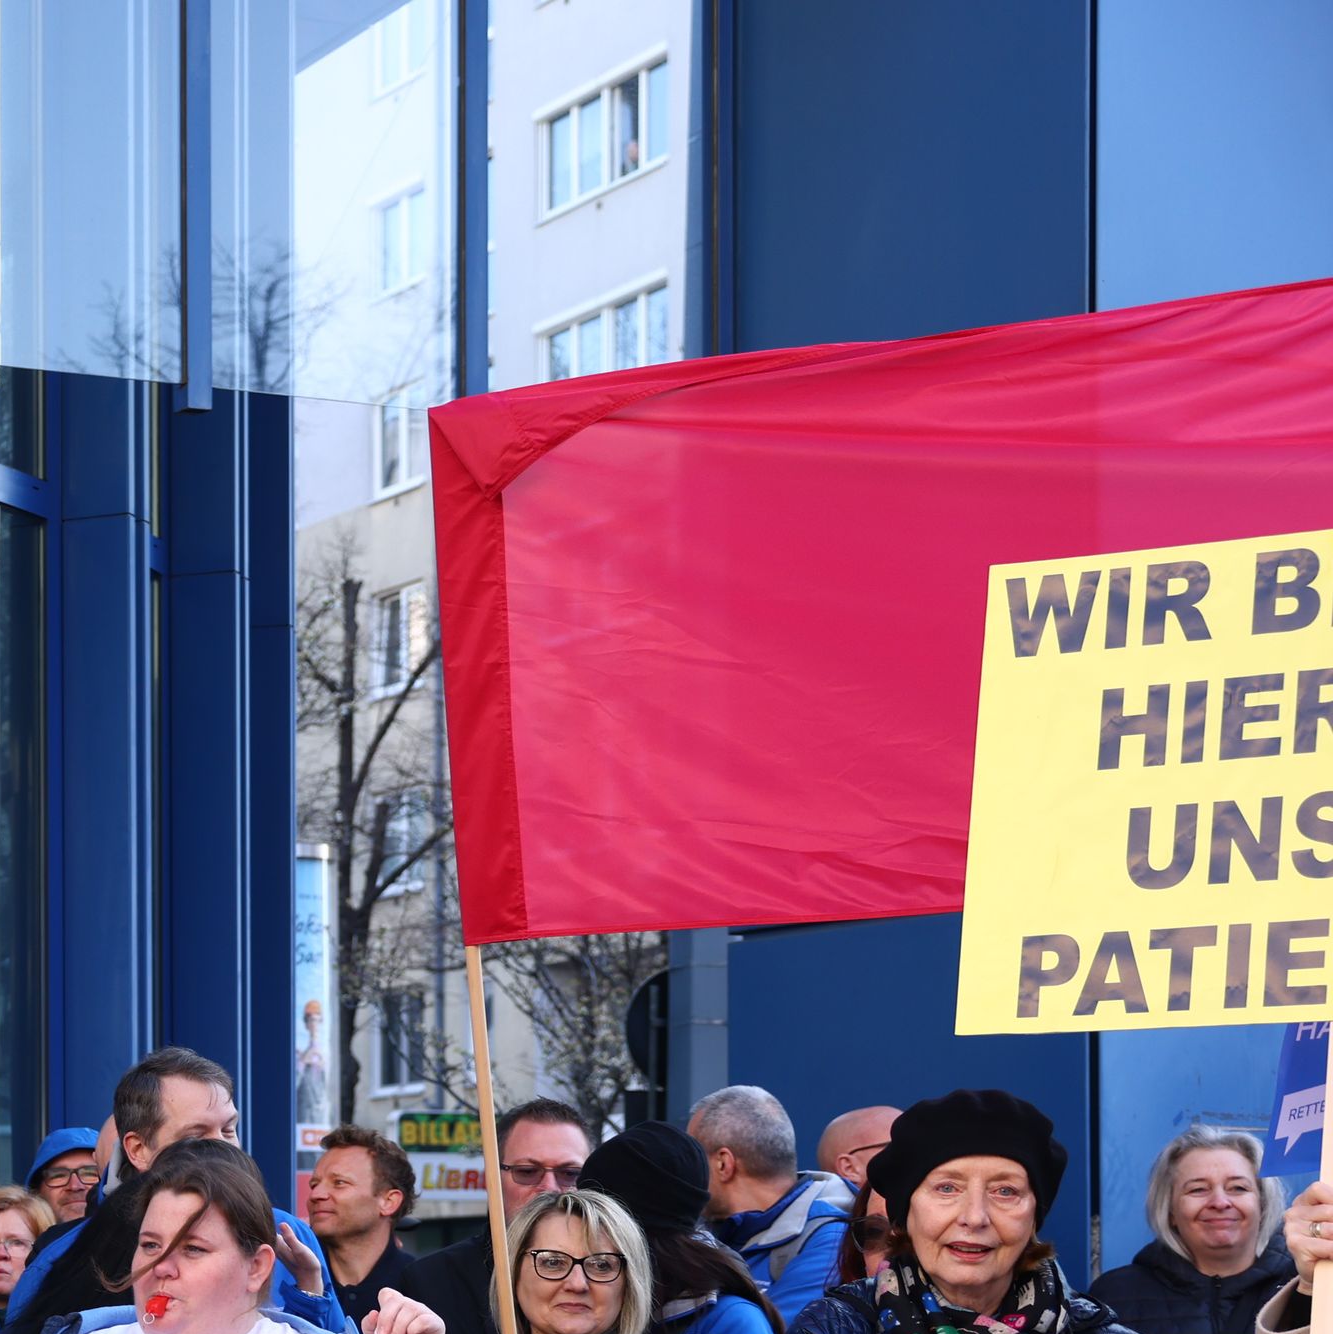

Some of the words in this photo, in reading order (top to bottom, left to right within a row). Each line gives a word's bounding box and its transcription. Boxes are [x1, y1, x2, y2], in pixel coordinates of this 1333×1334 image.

[1005, 560, 1213, 659] WIR
[1251, 547, 1333, 636] B
[1016, 918, 1331, 1019] PATIE
